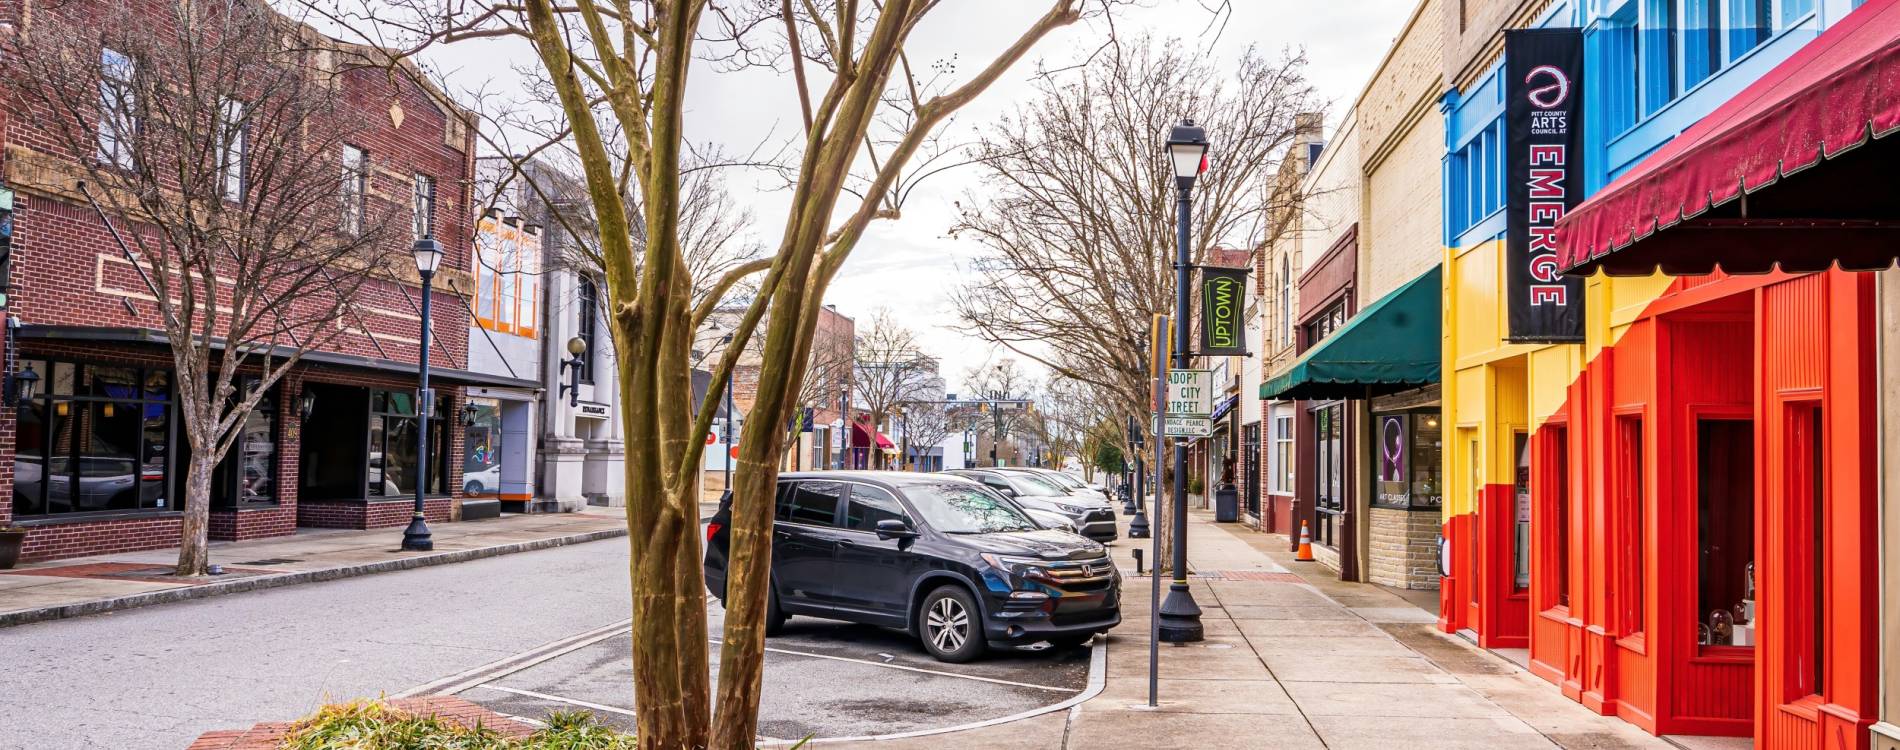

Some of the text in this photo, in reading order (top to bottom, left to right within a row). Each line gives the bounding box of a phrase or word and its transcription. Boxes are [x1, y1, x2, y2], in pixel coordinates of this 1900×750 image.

[1531, 116, 1567, 128] ARTS
[1526, 144, 1567, 306] EMERGE
[1215, 280, 1232, 346] UPTOWN
[1168, 372, 1198, 384] ADOPT
[1180, 387, 1201, 398] CITY
